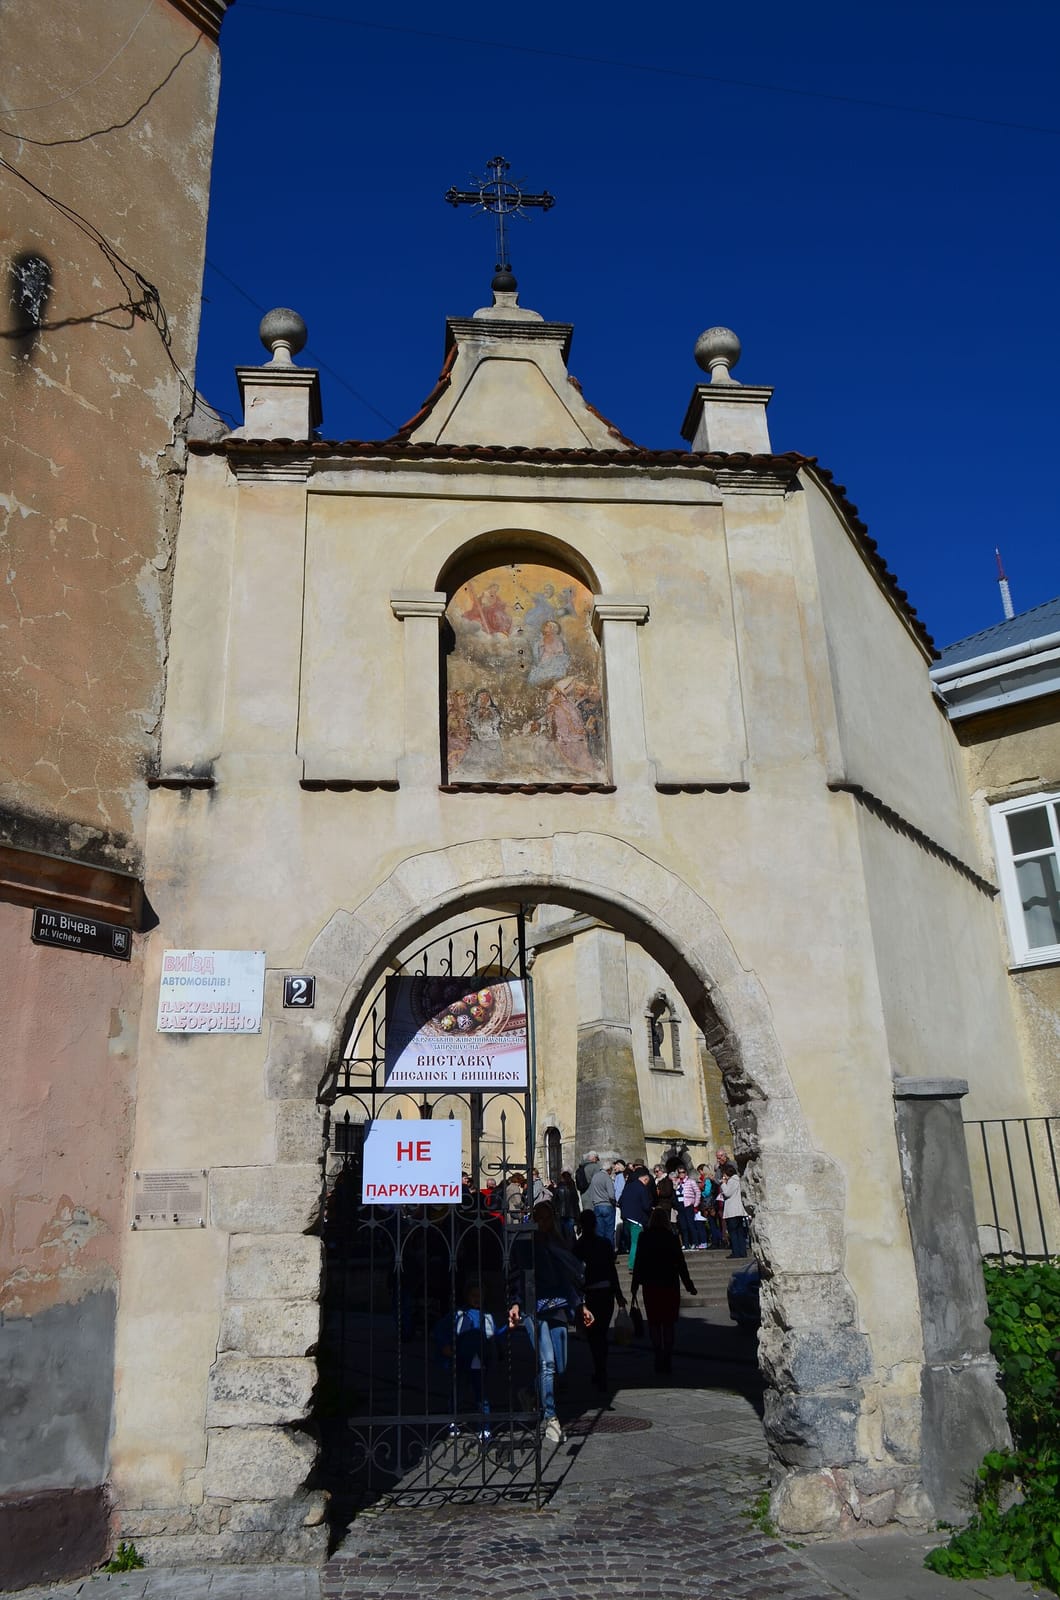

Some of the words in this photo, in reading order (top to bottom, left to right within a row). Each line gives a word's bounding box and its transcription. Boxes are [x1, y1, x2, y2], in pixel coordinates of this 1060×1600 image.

[41, 914, 58, 927] пл.
[60, 916, 97, 936] Вічева
[40, 928, 49, 937] pl.
[51, 929, 81, 943] Vicheva
[164, 954, 215, 975] ВИЇЗД
[291, 979, 307, 1003] 2
[160, 1002, 240, 1013] ПАРКУВАННЯ
[159, 1016, 261, 1030] ЗАБОРОНЕНО!
[417, 1055, 495, 1069] ВИСТАВКУ
[391, 1071, 448, 1081] ПИСАНОК
[461, 1071, 520, 1081] ВИШИВОК
[397, 1141, 431, 1161] НЕ
[366, 1184, 459, 1197] ПАРКУВАТИ
